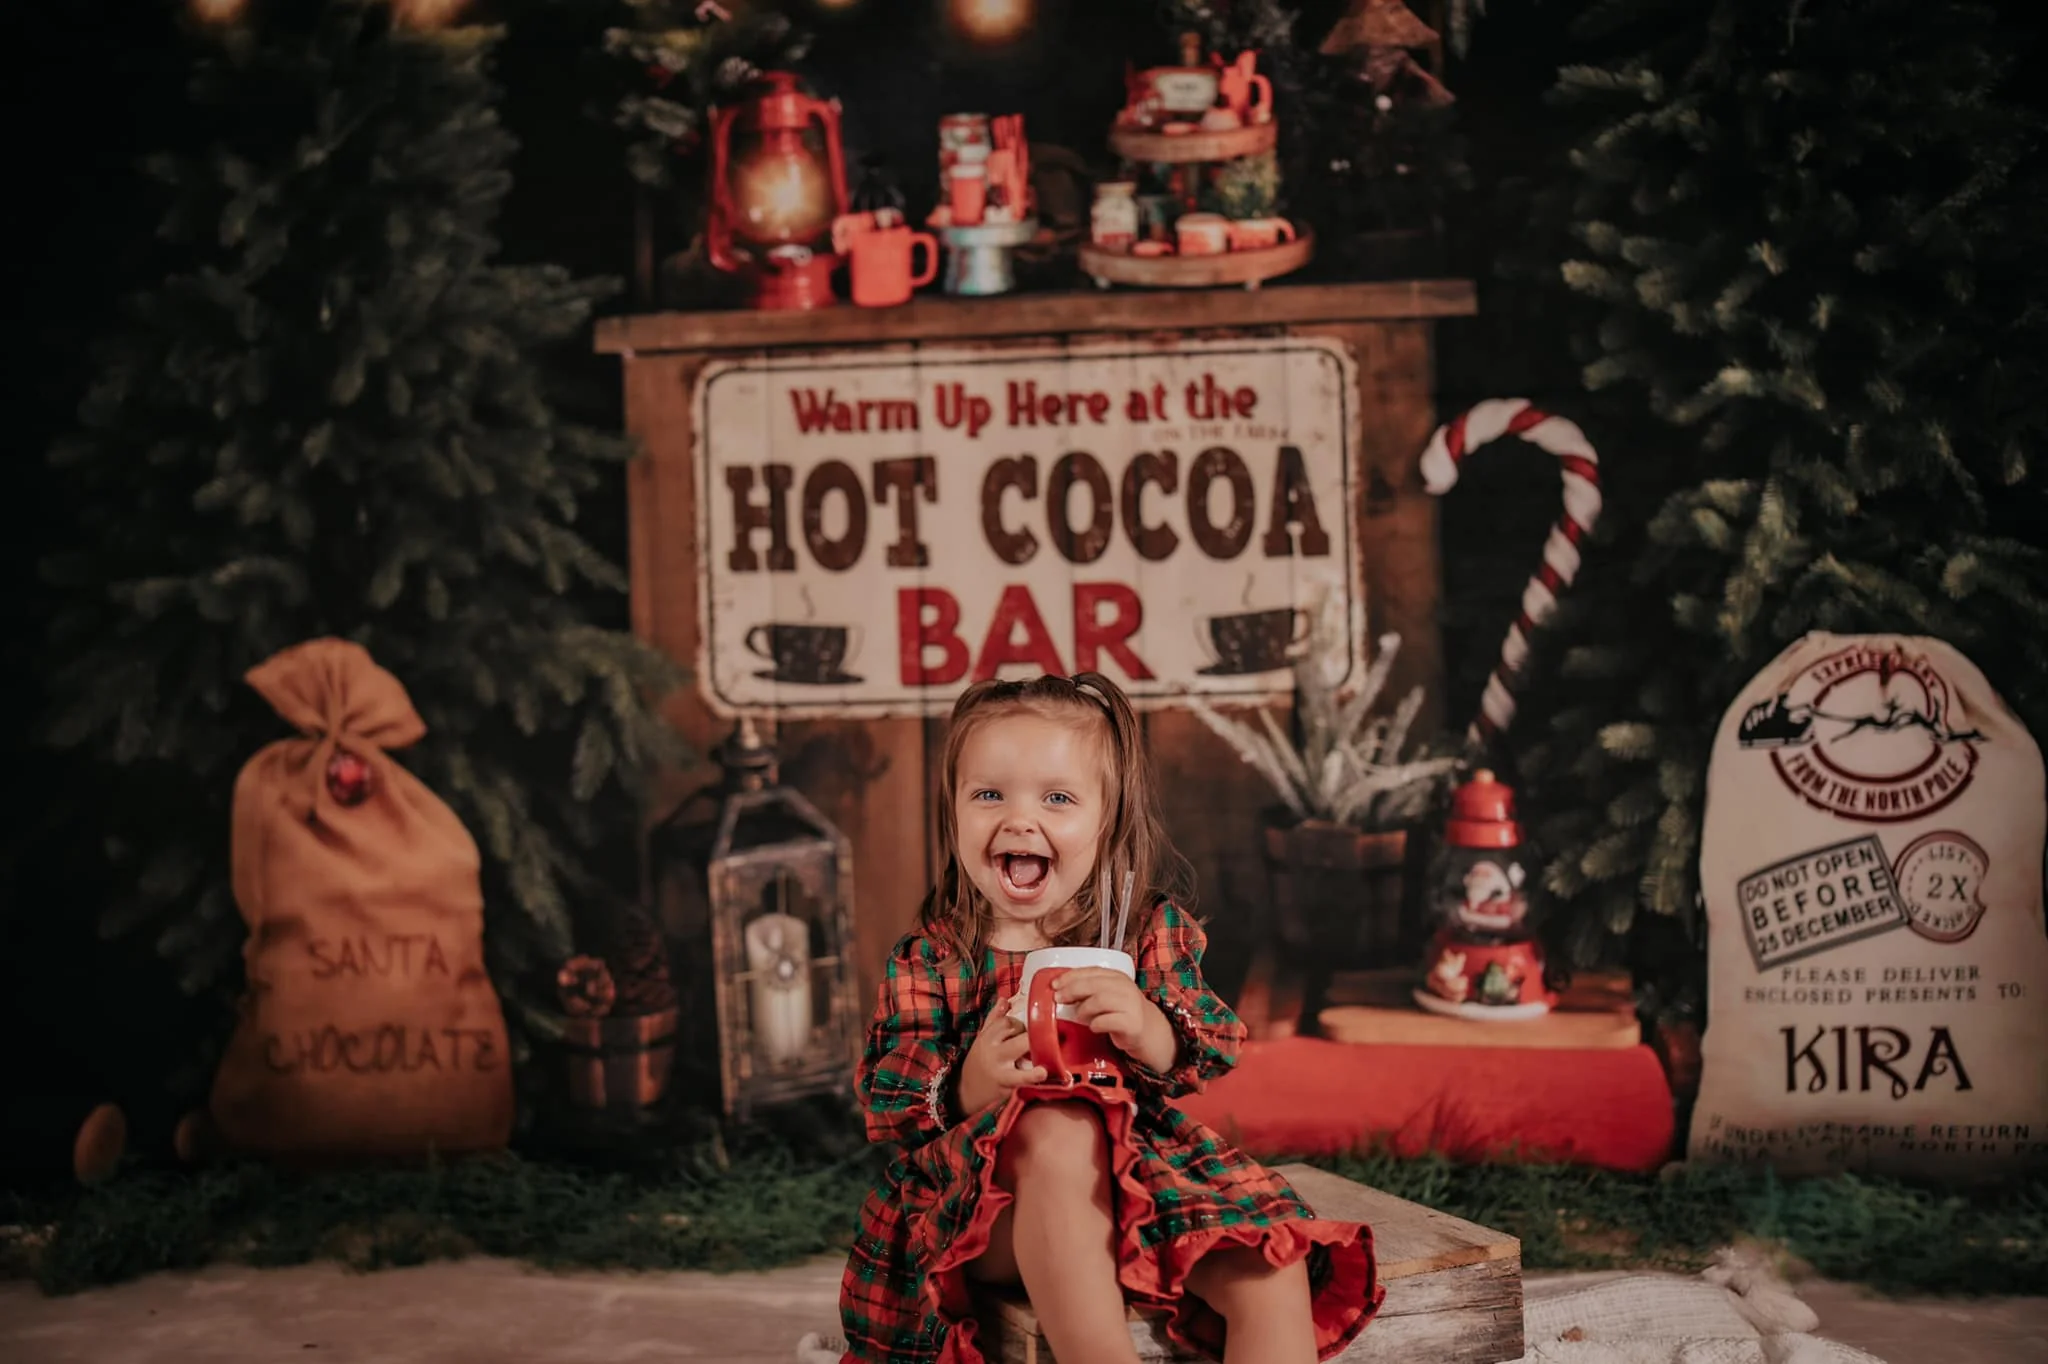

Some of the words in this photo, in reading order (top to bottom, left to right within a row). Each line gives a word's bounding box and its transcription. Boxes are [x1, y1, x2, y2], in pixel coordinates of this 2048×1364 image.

[789, 387, 919, 435] Warm
[934, 381, 992, 438] Up
[1007, 376, 1110, 428] Here
[1125, 380, 1168, 422] at
[1184, 372, 1258, 421] the
[725, 455, 937, 572] HOT
[980, 445, 1330, 565] COCOA
[896, 581, 1157, 687] BAR
[1786, 753, 1829, 795] FROM
[1828, 780, 1859, 808] THE
[1865, 784, 1925, 812] NORTH
[1925, 756, 1964, 797] POLE
[1746, 881, 1770, 903] DO
[1771, 864, 1810, 892] NOT
[1815, 846, 1875, 878] OPEN
[1928, 843, 1967, 863] LIST
[1752, 868, 1893, 931] BEFORE
[1758, 936, 1780, 956] 25
[1782, 897, 1895, 947] DECEMBER
[309, 934, 449, 979] SANTA
[1782, 967, 1867, 984] PLEASE
[1883, 965, 1981, 983] DELIVER
[1744, 986, 1851, 1006] ENCLOSED
[1866, 985, 1978, 1004] PRESENTS
[265, 1022, 499, 1075] CHOCOLATE
[1779, 1024, 1974, 1100] KIRA
[1930, 1123, 2030, 1140] RETURN
